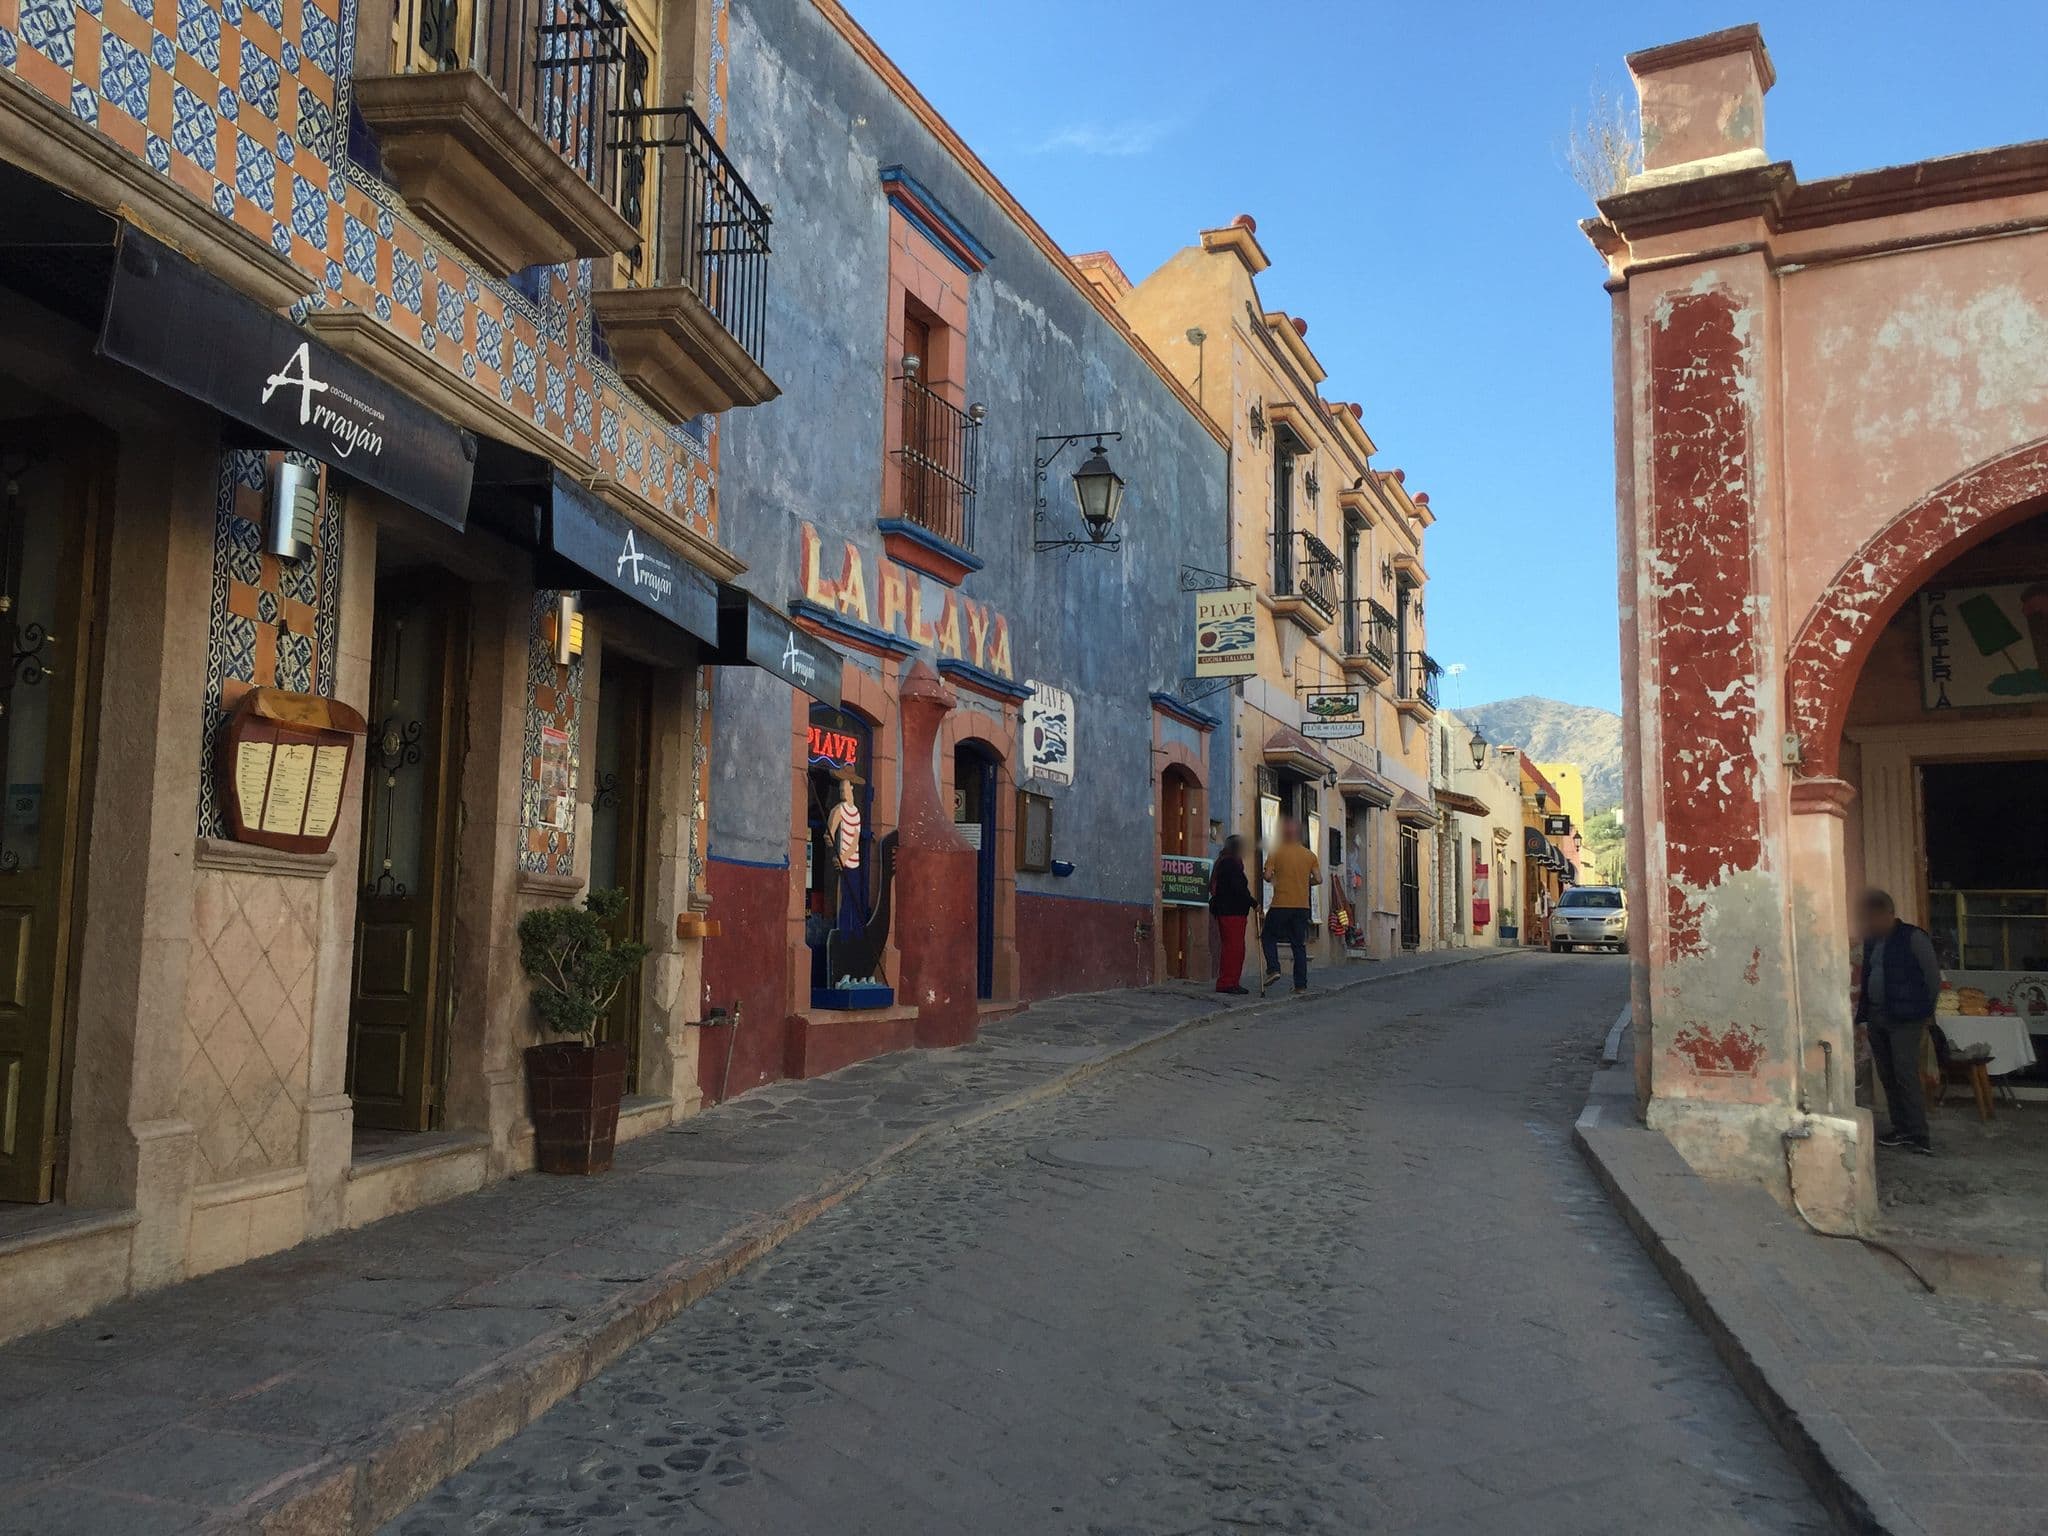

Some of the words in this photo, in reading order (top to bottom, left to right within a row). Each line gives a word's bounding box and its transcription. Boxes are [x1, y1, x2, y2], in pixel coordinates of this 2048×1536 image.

[262, 342, 384, 458] Arrayán
[330, 385, 353, 403] cocina
[353, 397, 385, 421] mexicana
[616, 529, 672, 602] Arrayán
[801, 521, 870, 624] LA
[878, 557, 1014, 682] PLAYA
[1199, 602, 1253, 618] PIAVE
[1201, 656, 1222, 664] CUCINA
[1033, 681, 1066, 712] PIAVE
[807, 726, 858, 763] PIAVE
[1169, 884, 1201, 895] NATURAL
